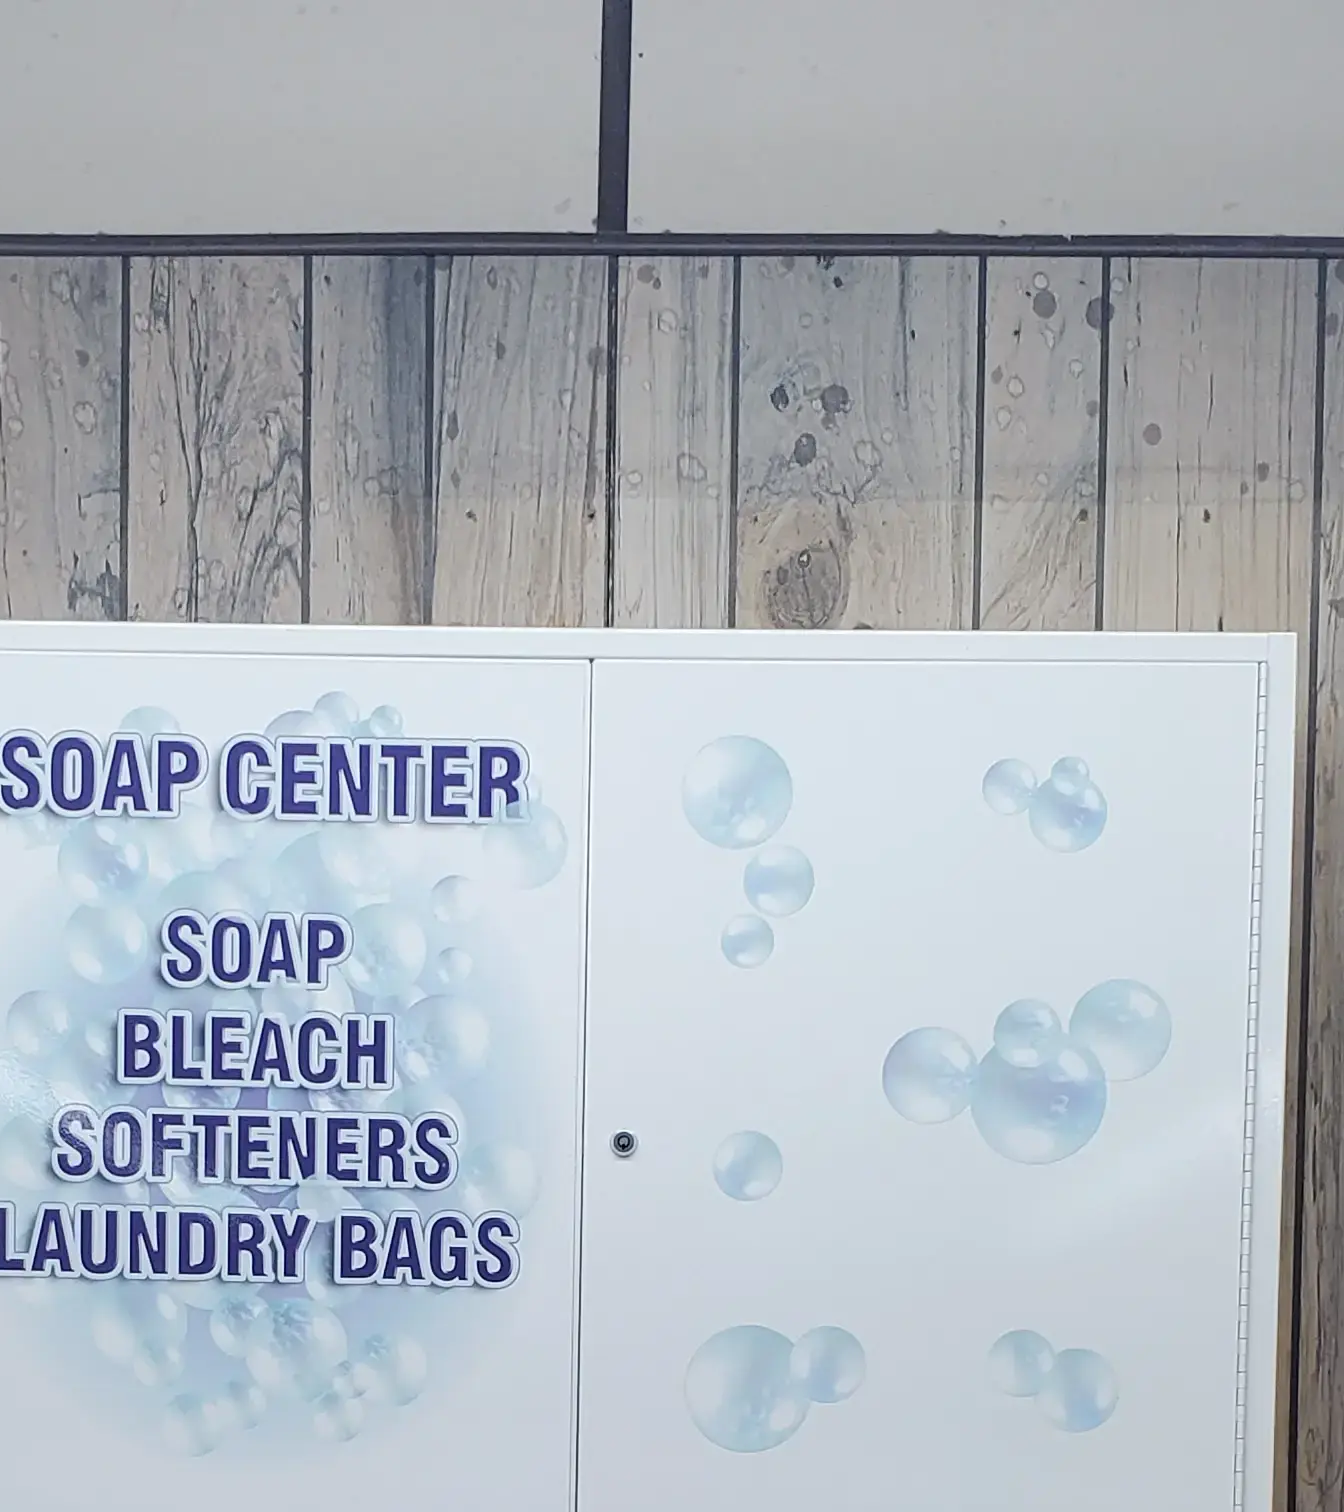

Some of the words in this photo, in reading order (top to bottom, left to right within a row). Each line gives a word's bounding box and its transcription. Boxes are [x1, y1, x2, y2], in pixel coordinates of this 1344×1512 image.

[0, 735, 202, 813] SOAP
[224, 739, 523, 818] CENTER
[166, 915, 346, 984] SOAP
[122, 1013, 390, 1085] BLEACH
[57, 1109, 453, 1184] SOFTENERS
[339, 1215, 514, 1283] BAGS
